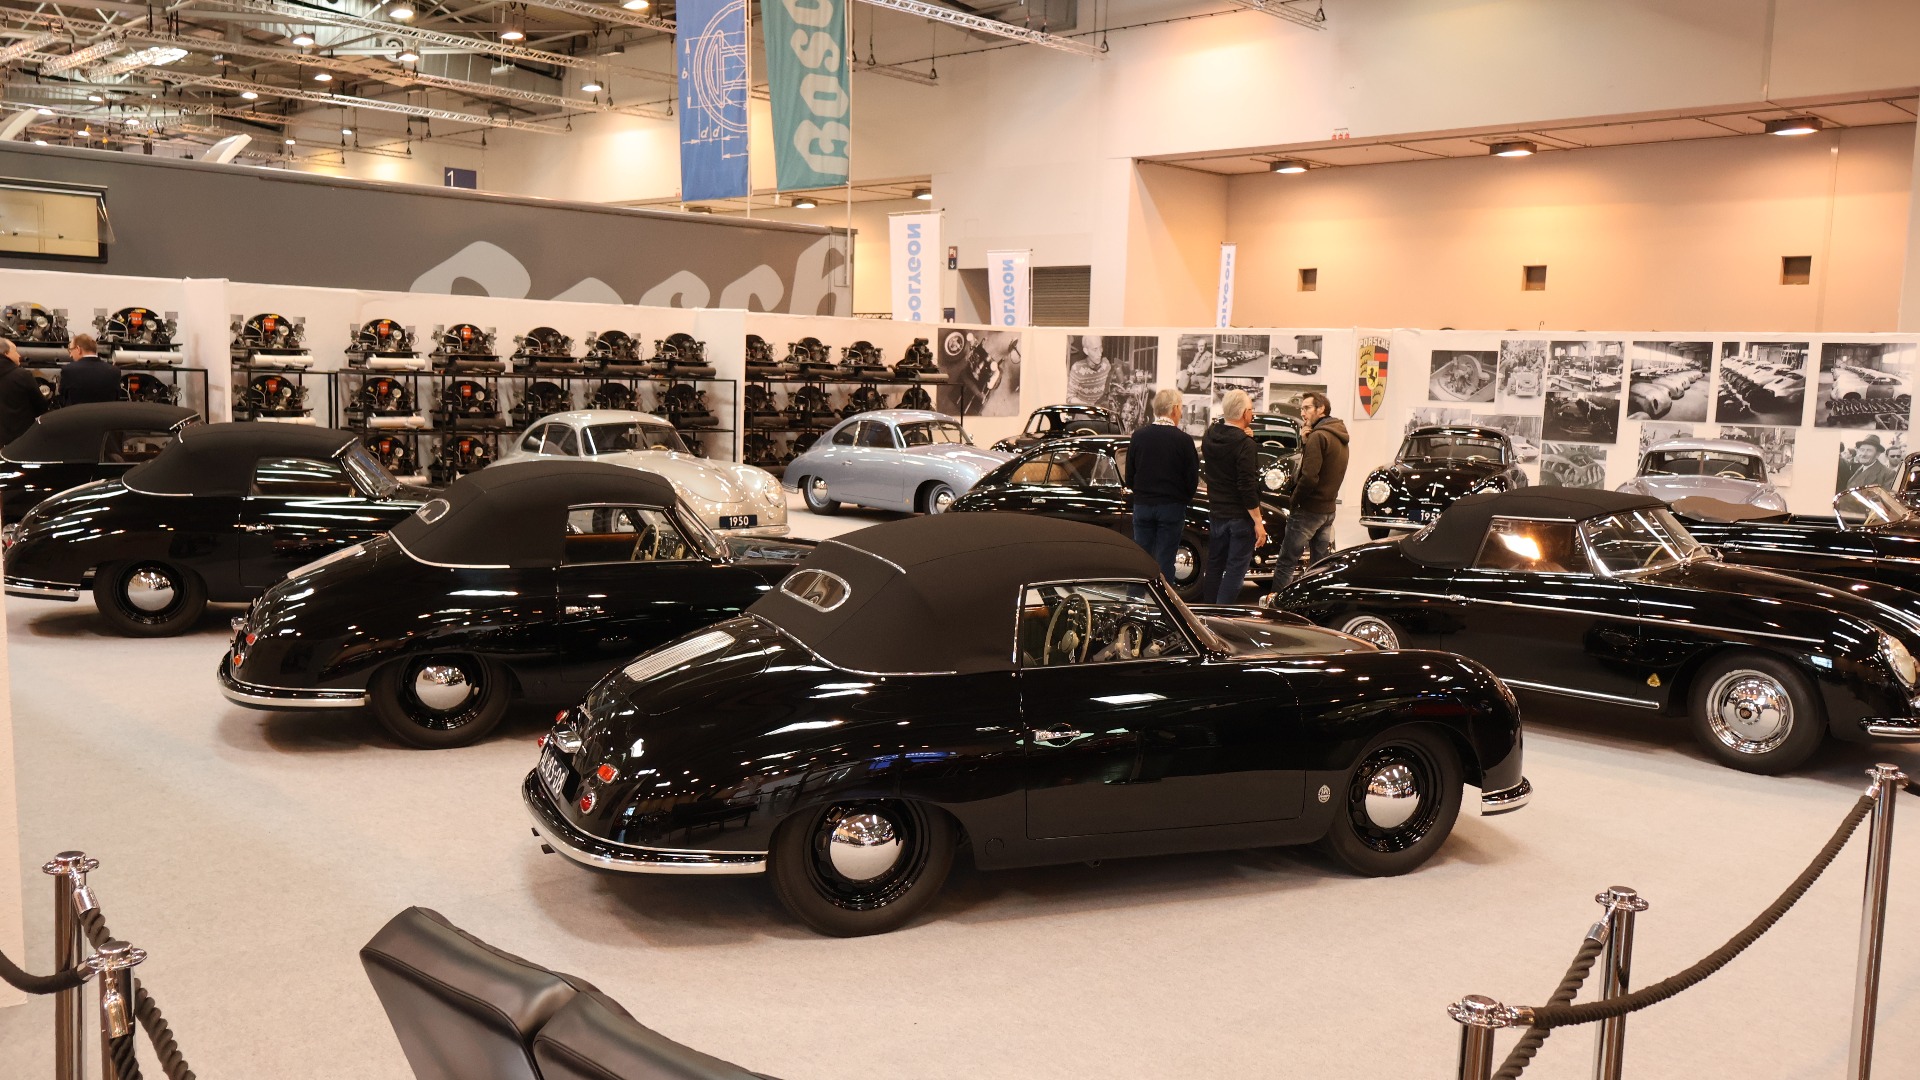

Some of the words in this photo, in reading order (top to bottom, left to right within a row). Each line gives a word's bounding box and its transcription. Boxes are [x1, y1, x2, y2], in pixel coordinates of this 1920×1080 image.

[1359, 336, 1390, 351] PORSCHE
[729, 515, 749, 527] 1950
[1420, 511, 1440, 522] 195
